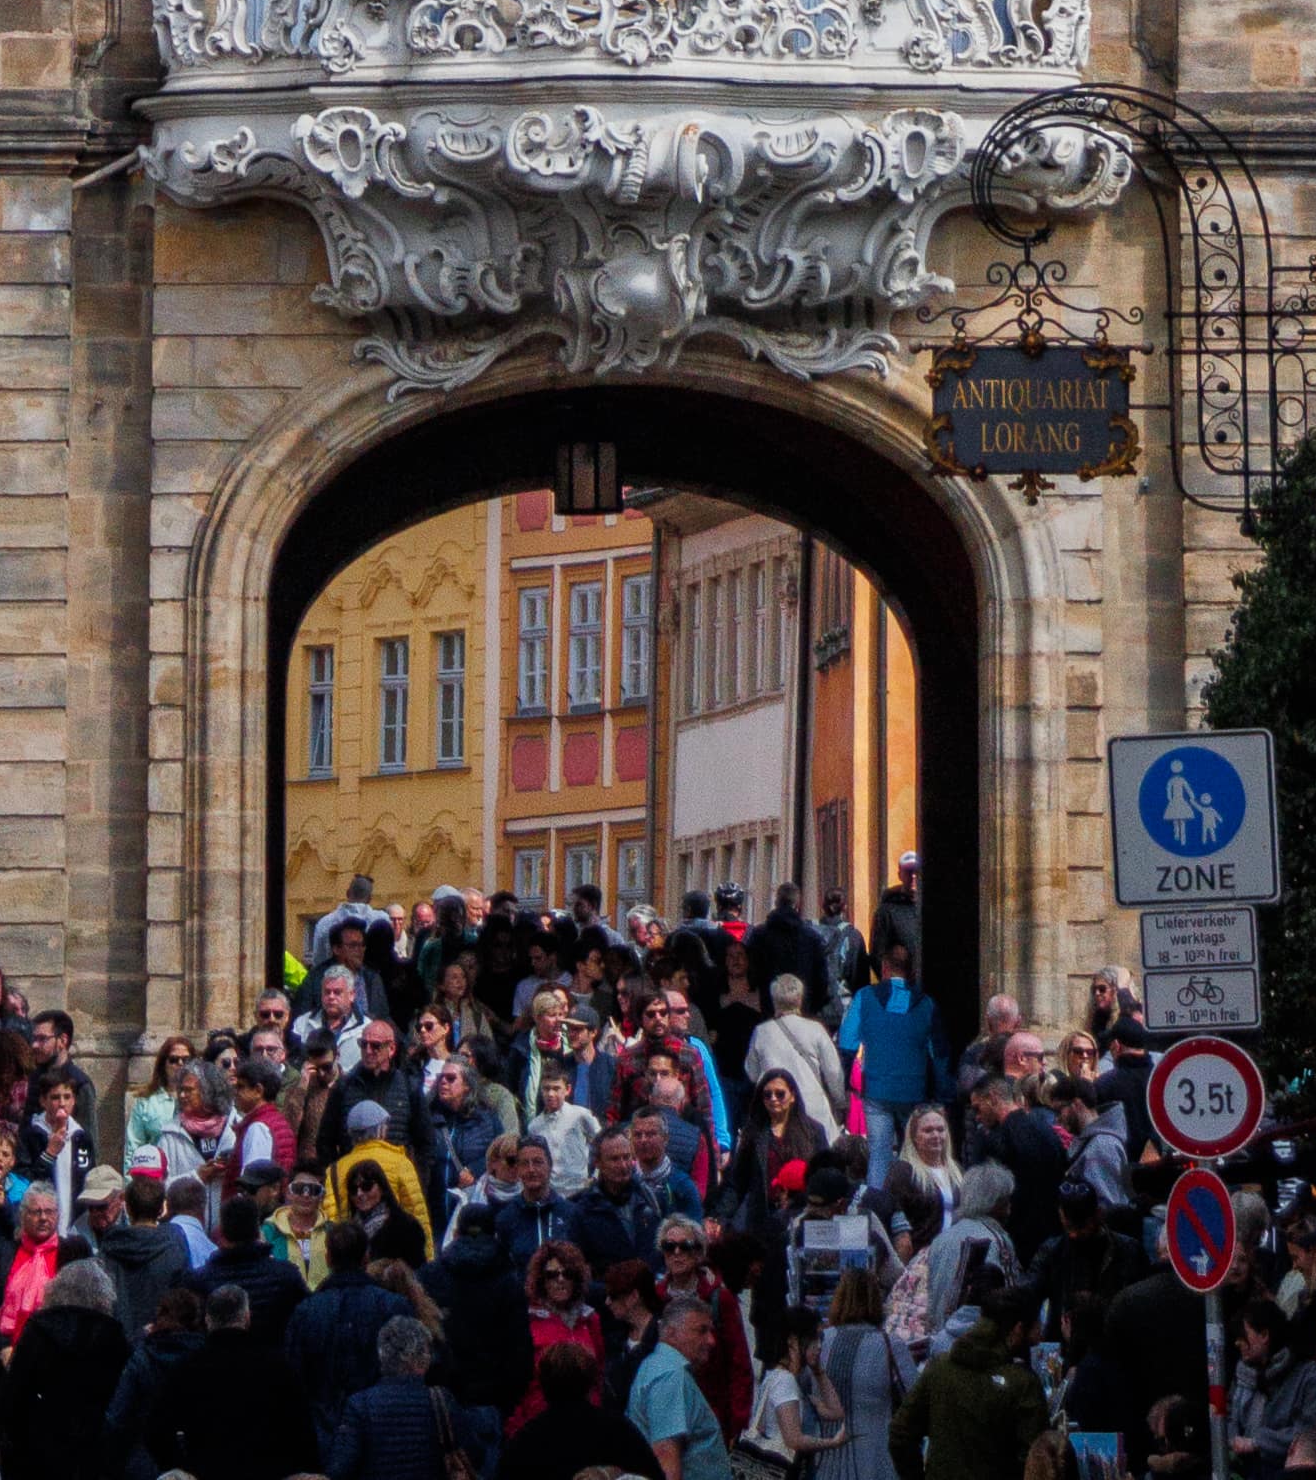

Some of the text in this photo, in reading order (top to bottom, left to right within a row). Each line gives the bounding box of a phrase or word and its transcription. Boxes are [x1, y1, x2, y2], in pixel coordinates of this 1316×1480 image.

[952, 378, 1111, 412] ANTIQUARIAT
[980, 422, 1081, 454] LORANG
[1156, 864, 1235, 892] ZONE
[1155, 915, 1237, 930] Lieferverkehr
[1170, 932, 1226, 946] werktags
[1219, 949, 1241, 961] frei
[1221, 1009, 1241, 1021] frei
[1177, 1078, 1236, 1118] 3,5t
